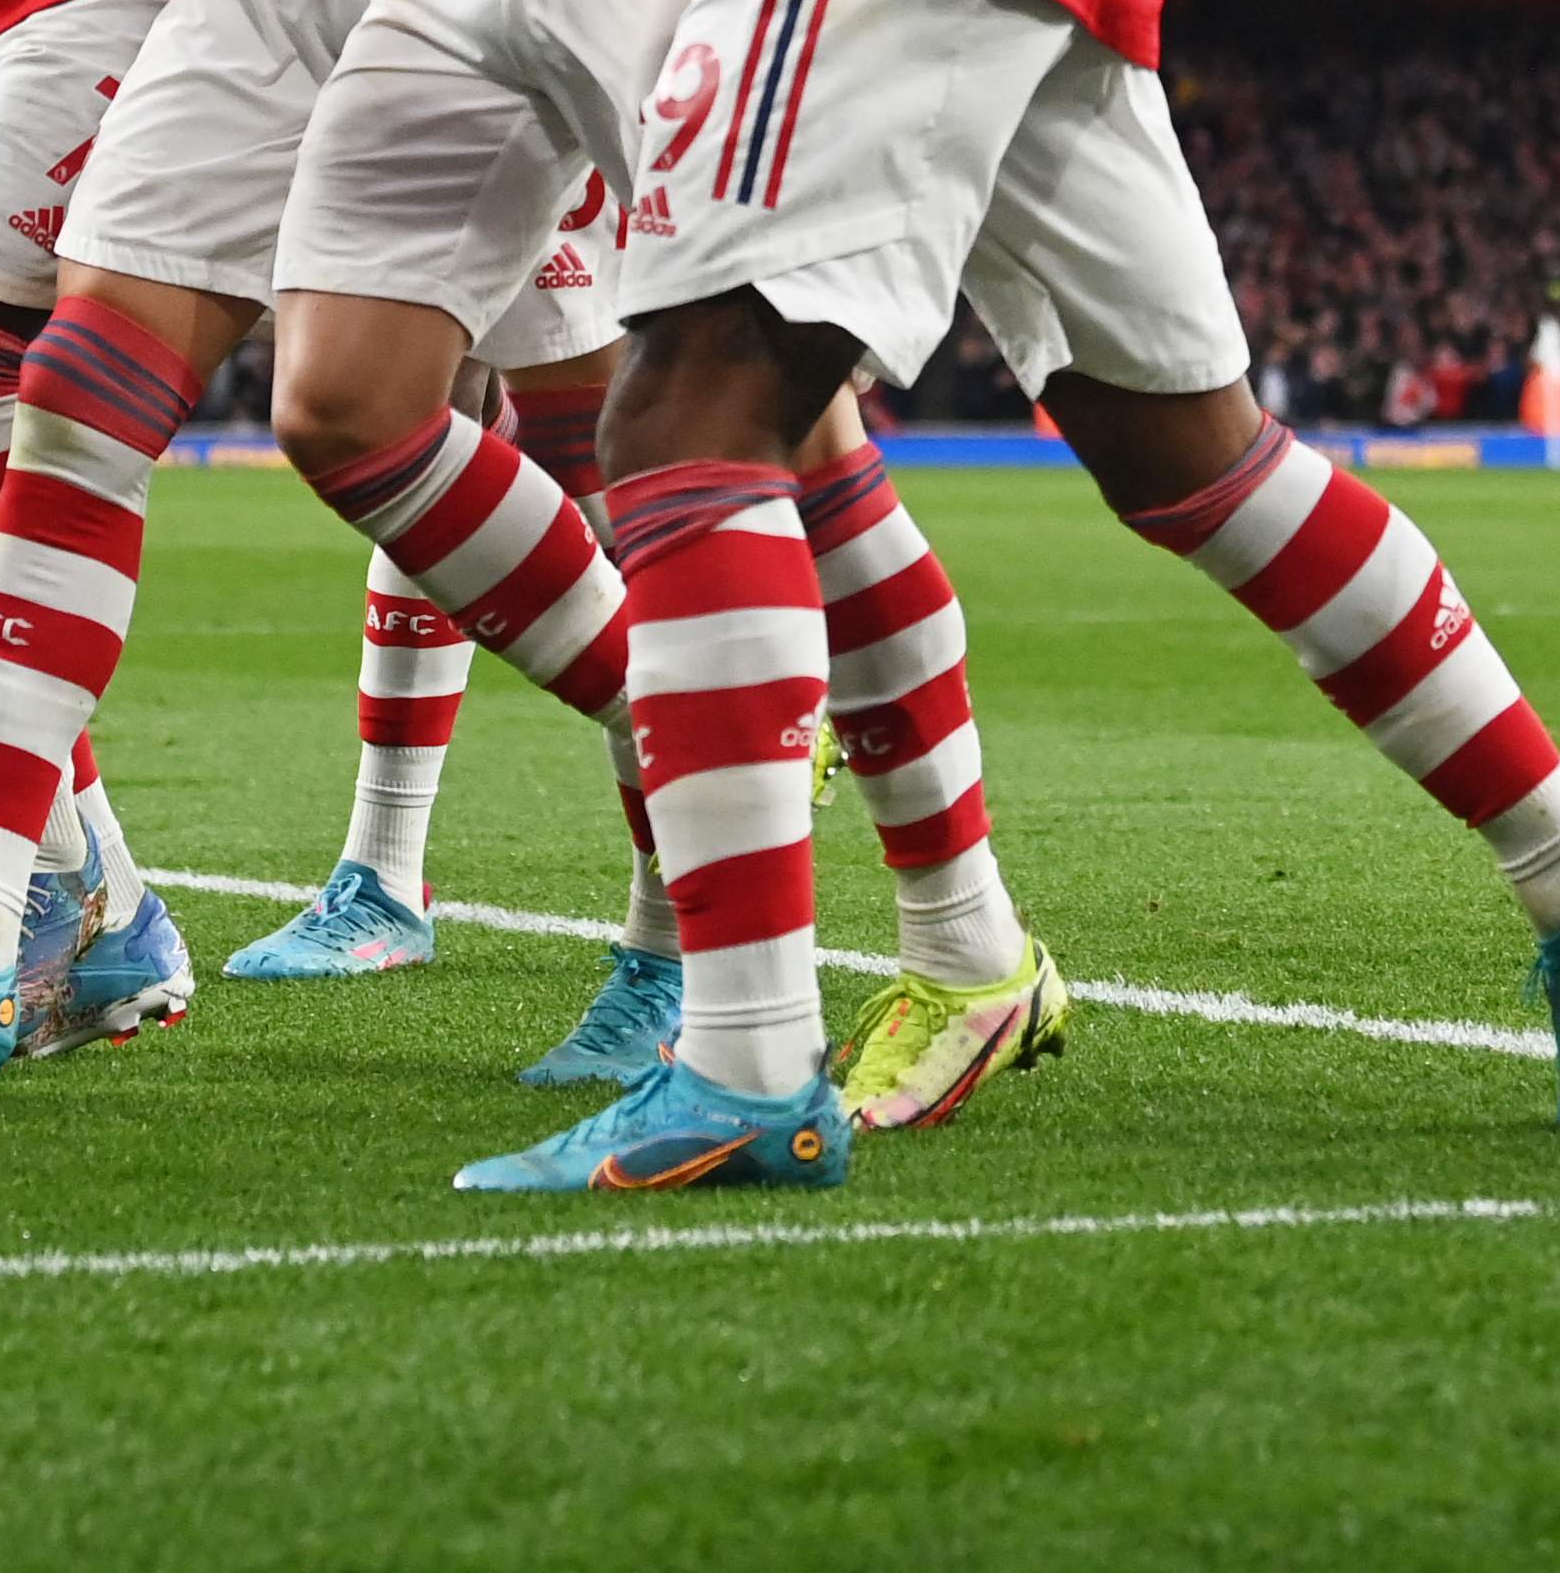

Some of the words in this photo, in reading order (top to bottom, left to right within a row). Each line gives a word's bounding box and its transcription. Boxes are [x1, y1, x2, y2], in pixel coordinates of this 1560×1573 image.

[649, 43, 721, 173] 9
[8, 213, 58, 257] adida
[535, 271, 593, 291] adidas
[366, 603, 437, 635] AFC
